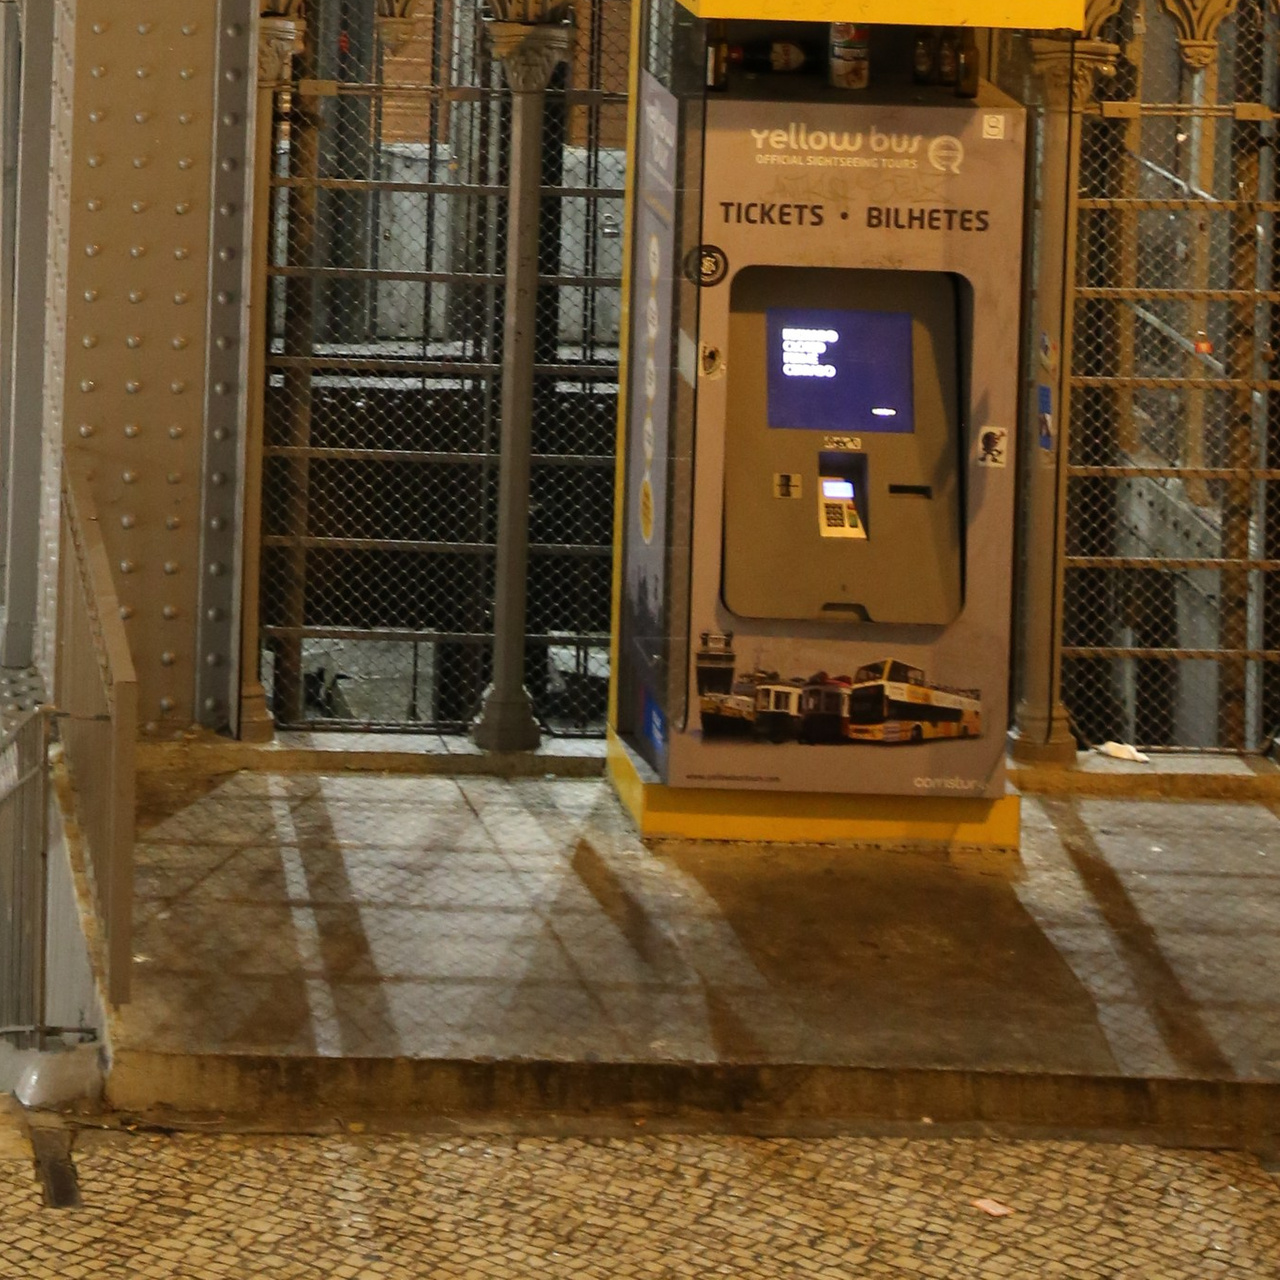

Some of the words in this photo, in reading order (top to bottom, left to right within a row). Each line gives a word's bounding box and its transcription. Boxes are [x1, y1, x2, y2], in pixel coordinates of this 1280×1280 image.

[869, 124, 923, 153] bus
[755, 153, 804, 167] OFFICIAL
[806, 155, 878, 169] SIGHTSEEING
[881, 157, 919, 170] TOURS
[719, 201, 824, 227] TICKETS
[866, 206, 990, 232] BILHETES
